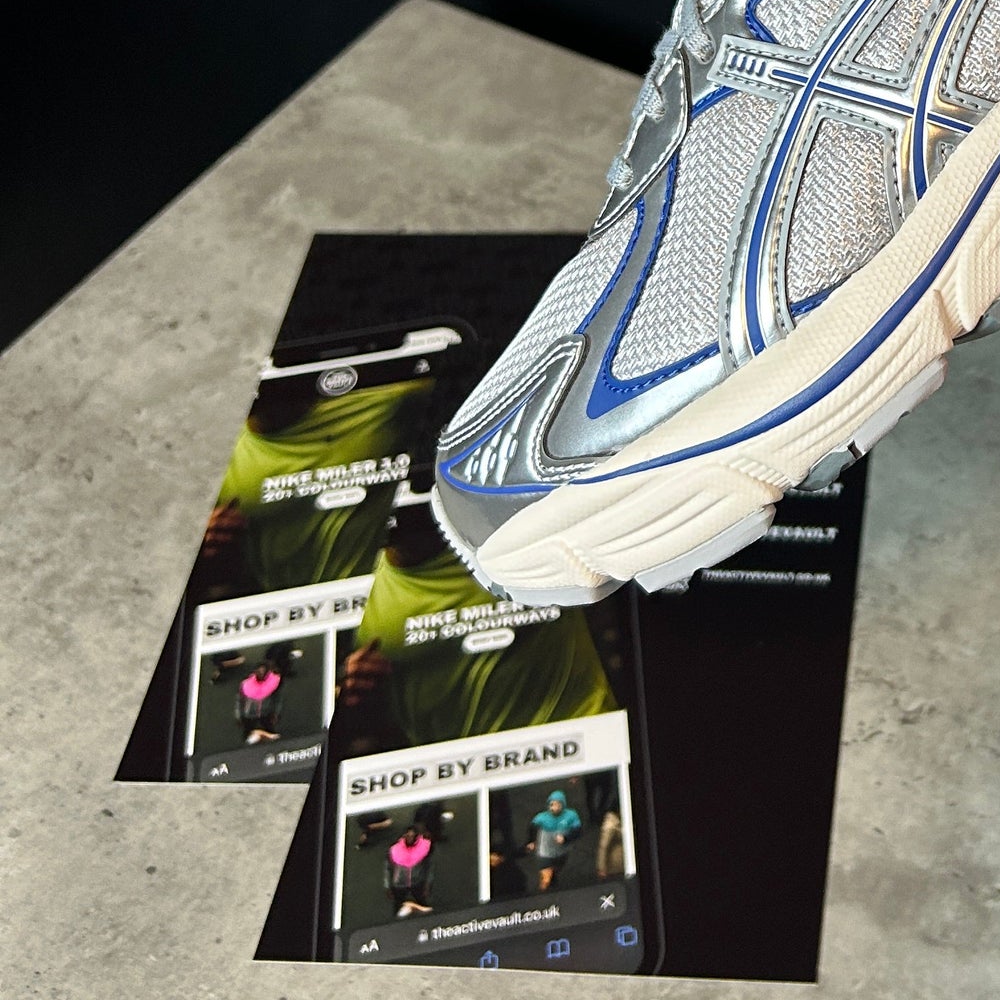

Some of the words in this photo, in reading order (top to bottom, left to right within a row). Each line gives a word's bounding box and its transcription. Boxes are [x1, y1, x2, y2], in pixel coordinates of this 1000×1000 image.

[262, 470, 313, 490] NIKE
[315, 459, 377, 481] MILER
[206, 611, 280, 636] SHOP
[289, 602, 322, 622] BY
[406, 608, 458, 630] NIKE
[440, 605, 562, 639] COLOURWAYS
[350, 767, 426, 795] SHOP
[438, 759, 475, 780] BY
[485, 741, 580, 771] BRAND
[431, 905, 560, 940] theactivevault.co.uk
